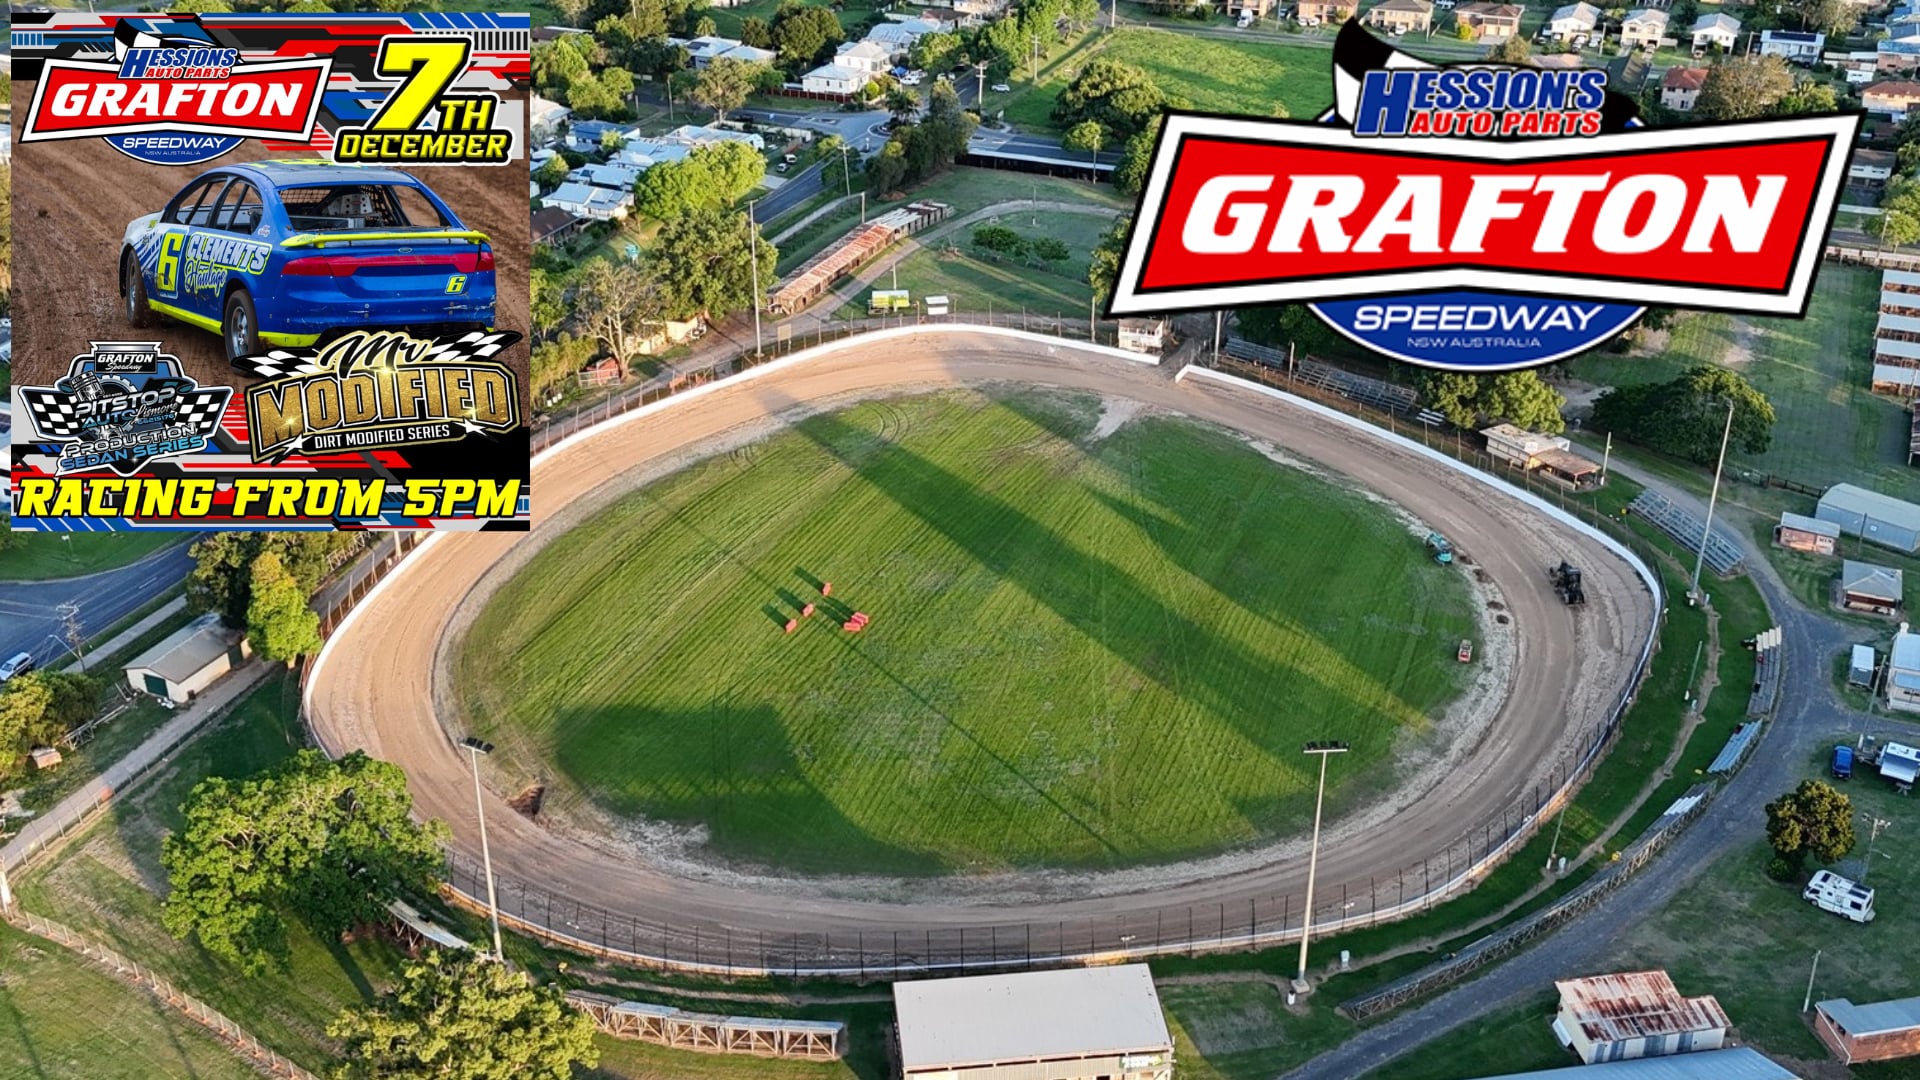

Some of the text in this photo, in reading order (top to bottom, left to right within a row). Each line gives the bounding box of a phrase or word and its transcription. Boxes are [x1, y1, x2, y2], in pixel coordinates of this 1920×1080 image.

[157, 232, 185, 292] 6
[187, 234, 269, 271] CLEMENTS
[185, 259, 227, 296] Haulage
[446, 275, 467, 293] 6
